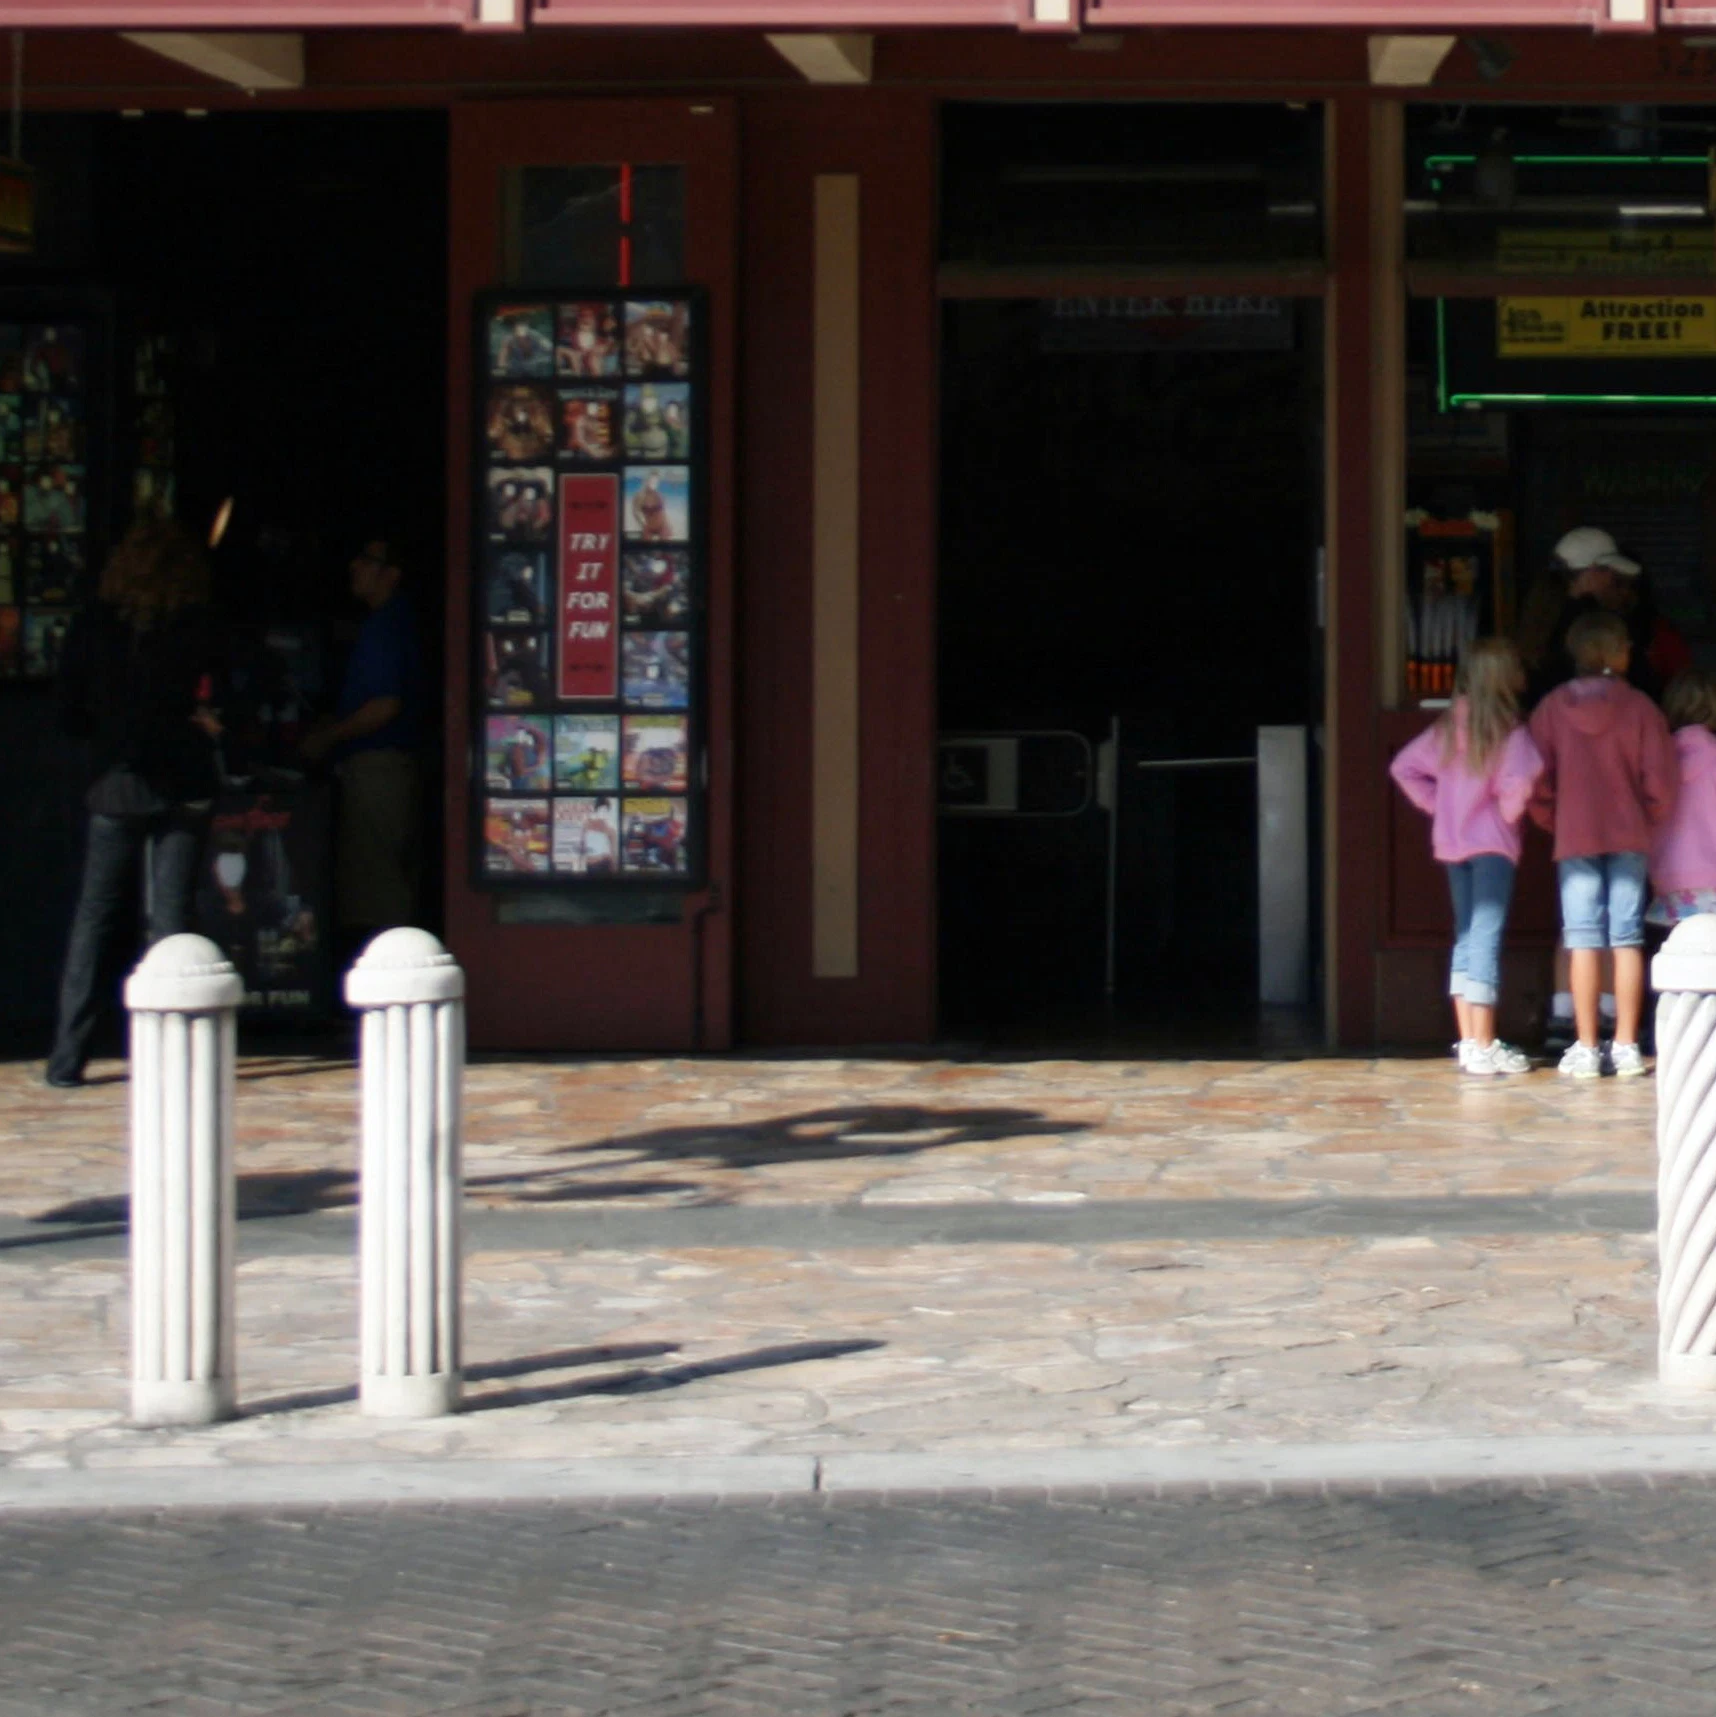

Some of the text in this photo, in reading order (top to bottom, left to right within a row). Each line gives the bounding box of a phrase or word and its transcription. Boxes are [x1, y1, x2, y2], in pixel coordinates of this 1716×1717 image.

[1581, 299, 1705, 318] Attraction
[1601, 321, 1683, 341] FREE!
[569, 533, 611, 551] TRY
[576, 562, 603, 581] IT
[567, 592, 610, 609] FOR
[569, 620, 610, 639] FUN
